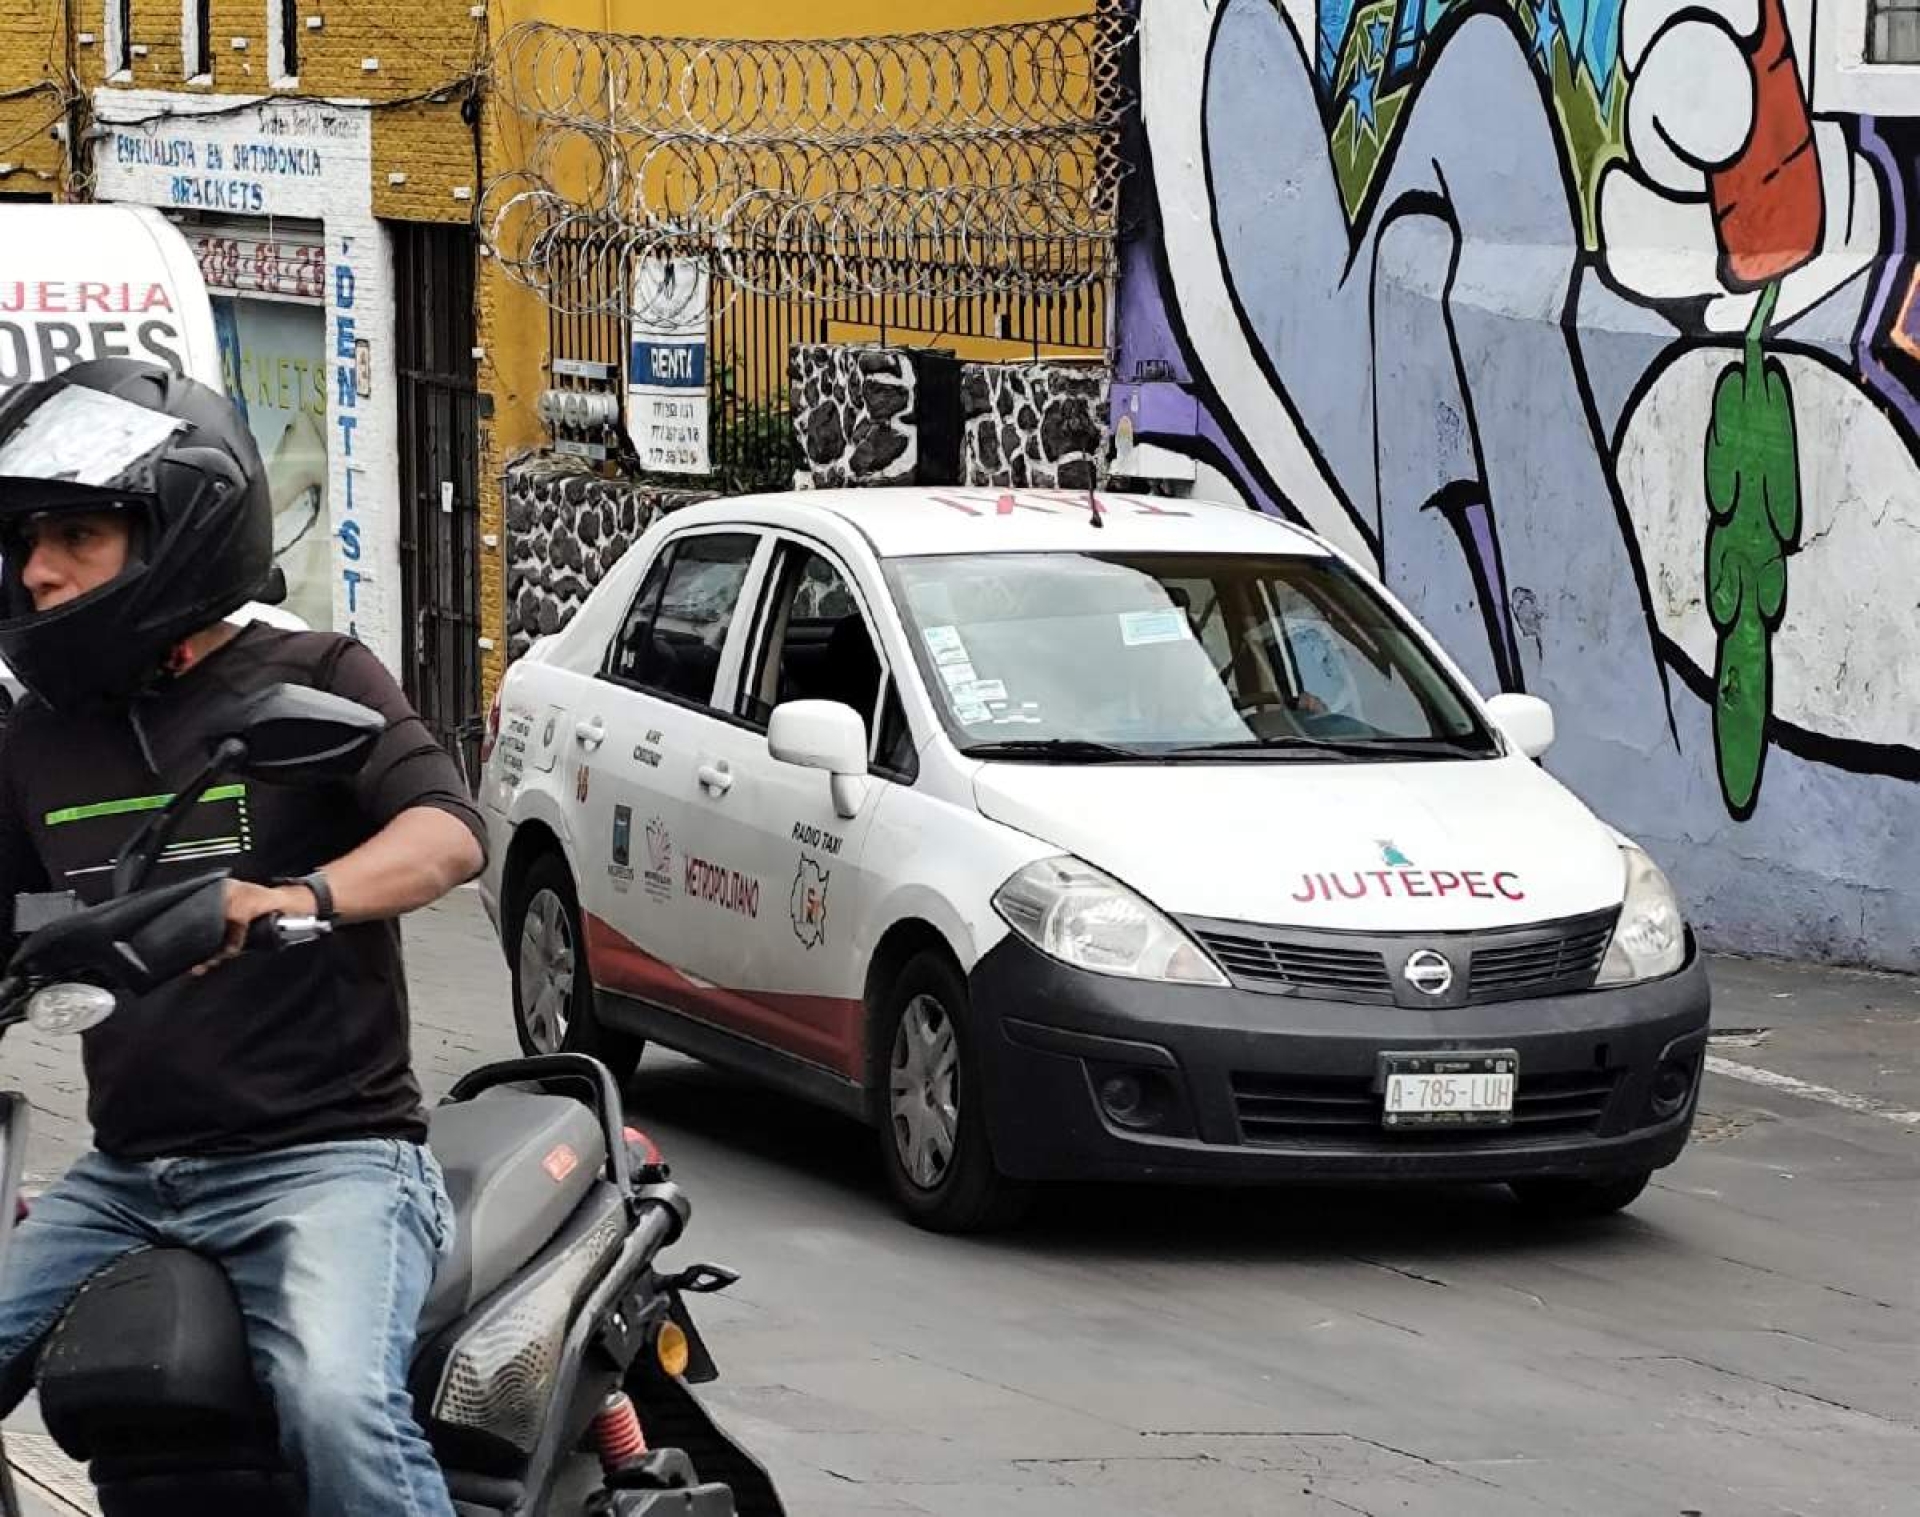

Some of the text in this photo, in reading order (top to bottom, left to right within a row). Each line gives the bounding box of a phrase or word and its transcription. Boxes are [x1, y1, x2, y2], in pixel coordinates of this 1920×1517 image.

[116, 134, 196, 168] ESPECIALISTA
[232, 144, 321, 177] ORTODONCIA
[650, 347, 693, 380] RENTA
[791, 820, 845, 855] RADIO TAXI
[684, 854, 760, 919] METROPOLITANO
[1291, 871, 1525, 902] JIUTEPEC
